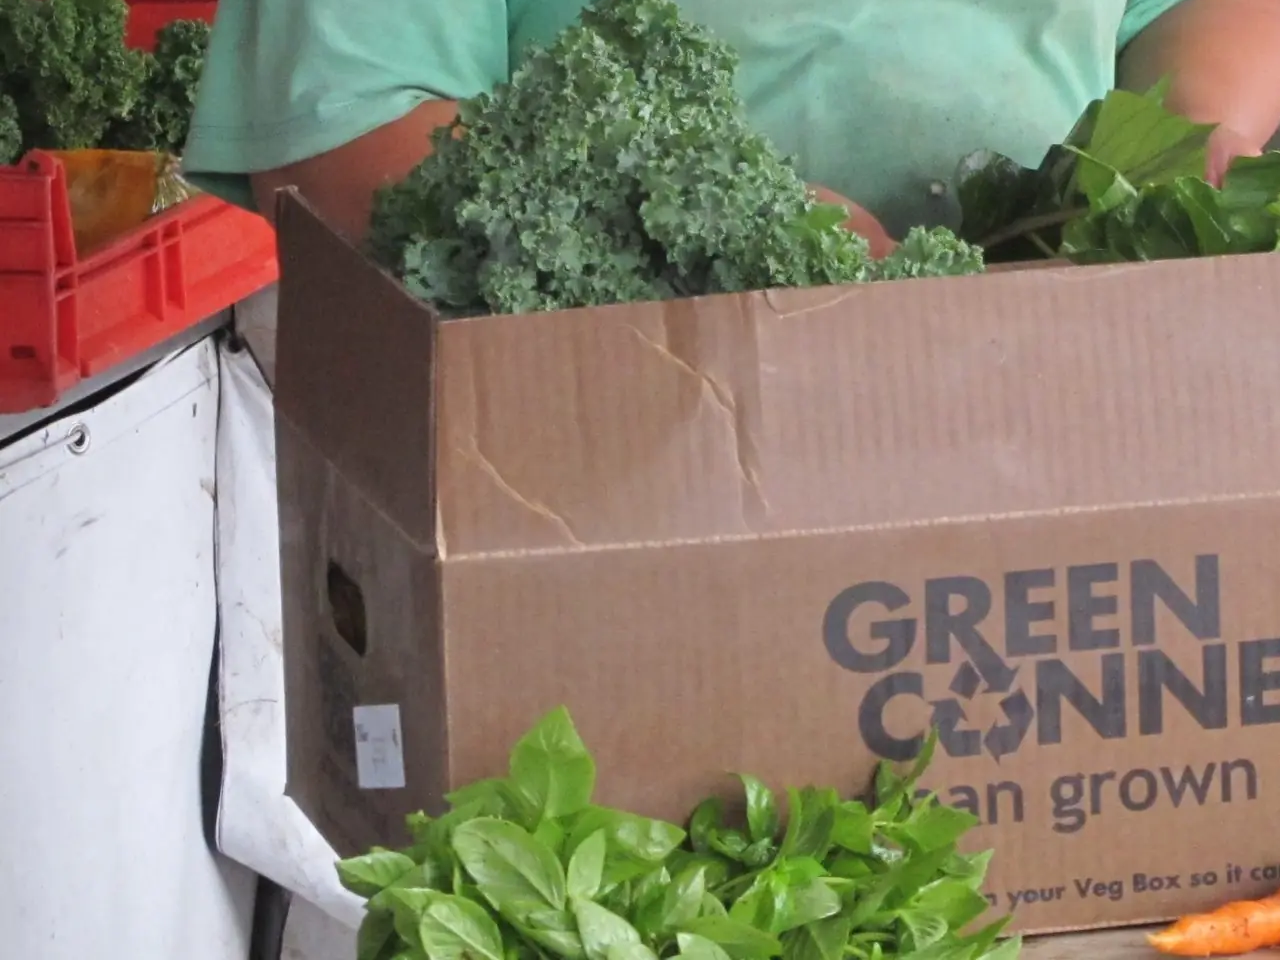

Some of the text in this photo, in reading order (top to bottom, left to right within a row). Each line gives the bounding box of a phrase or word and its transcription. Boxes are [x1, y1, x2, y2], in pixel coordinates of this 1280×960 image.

[822, 554, 1220, 673] GREEN
[1051, 751, 1258, 834] grown
[1007, 883, 1066, 912] your
[1074, 878, 1124, 901] Veg
[1132, 872, 1182, 893] Box
[1190, 871, 1218, 888] so
[1226, 862, 1243, 884] it
